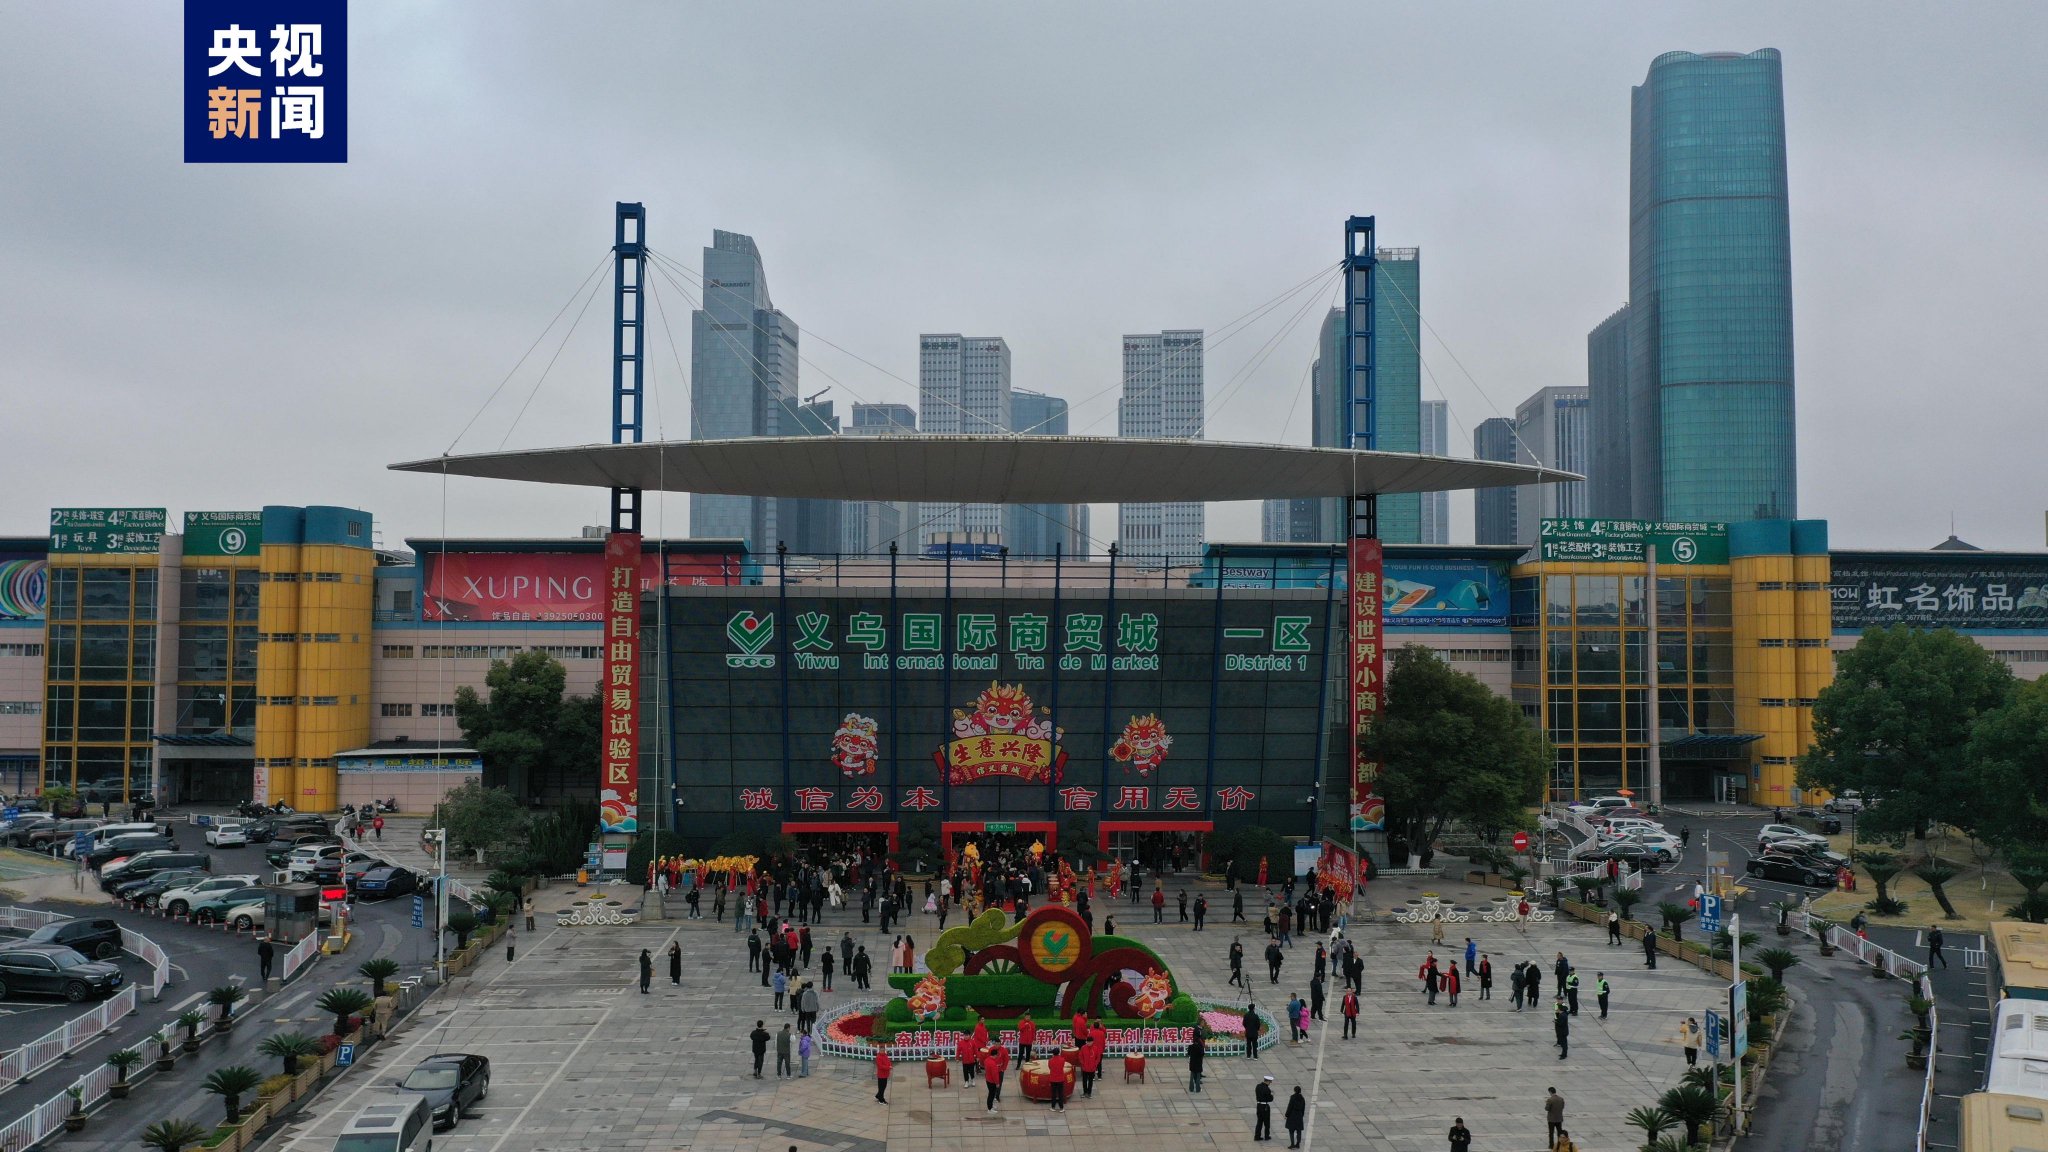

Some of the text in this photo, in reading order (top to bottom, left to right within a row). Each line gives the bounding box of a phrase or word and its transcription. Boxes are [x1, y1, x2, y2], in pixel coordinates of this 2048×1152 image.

[52, 511, 62, 525] 2
[108, 511, 120, 525] 4
[1542, 521, 1552, 535] 2
[1591, 521, 1601, 535] 4
[52, 534, 60, 548] 1
[107, 534, 117, 548] 3
[1545, 543, 1552, 557] 1
[1592, 543, 1602, 557] 3
[1222, 567, 1270, 580] Bestway
[463, 576, 593, 600] XUPING
[1866, 582, 2014, 612] 虹名饰品
[793, 610, 1311, 651] 义乌国际商贸城 一区
[793, 652, 839, 669] Yiwu
[1225, 653, 1291, 671] District
[1296, 653, 1308, 671] 1
[608, 566, 633, 784] 打造自由贸易试验区
[1355, 572, 1378, 784] 建设世界小商品都
[953, 737, 1045, 763] 生意兴隆
[740, 785, 1255, 811] 诚信为本 信用无价
[1703, 895, 1716, 917] P
[1708, 1013, 1716, 1037] P
[1106, 1027, 1195, 1043] 再创新辉煌
[340, 1046, 351, 1060] P
